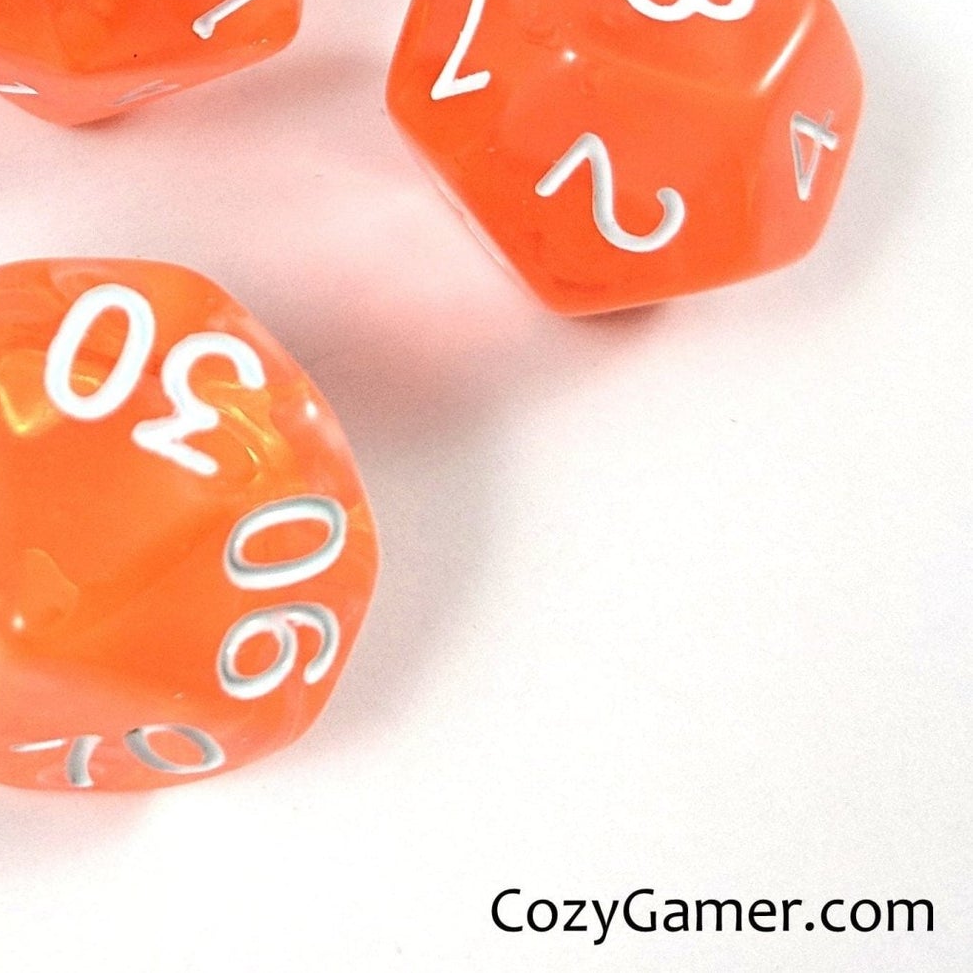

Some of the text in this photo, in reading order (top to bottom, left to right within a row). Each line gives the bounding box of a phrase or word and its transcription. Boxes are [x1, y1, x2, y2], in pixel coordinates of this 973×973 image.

[535, 132, 685, 252] 2
[790, 108, 838, 201] 4
[44, 283, 266, 475] 30
